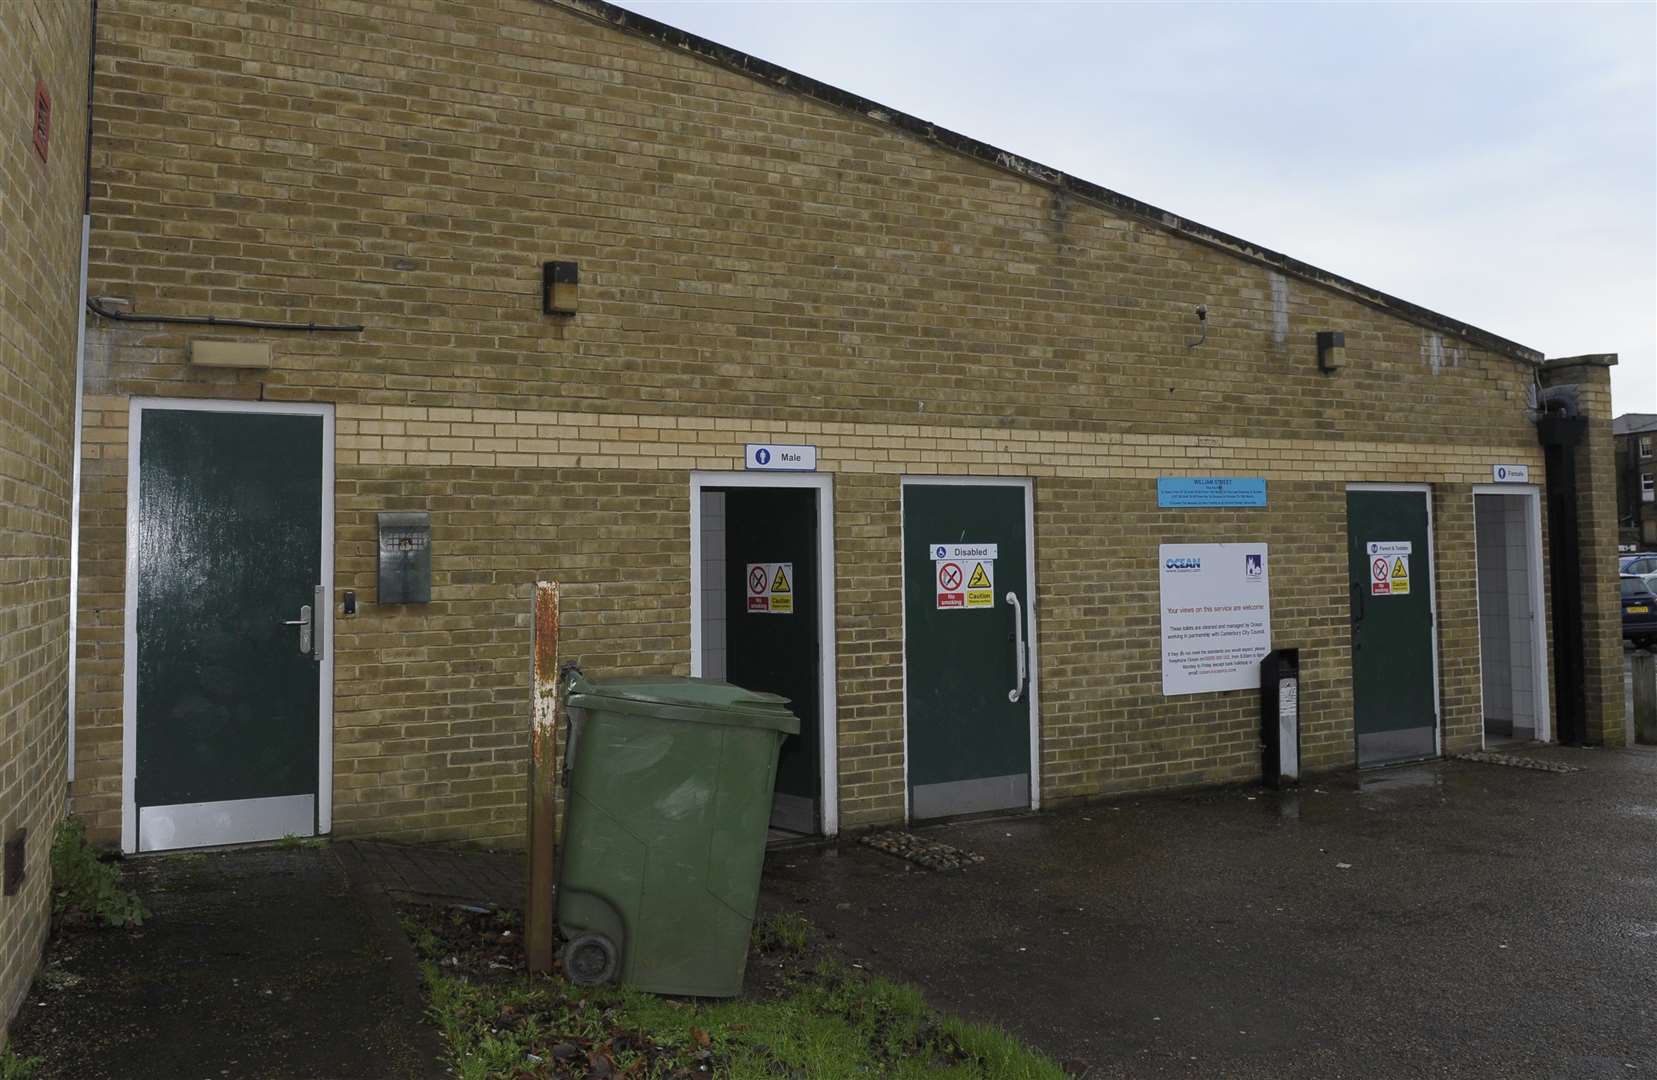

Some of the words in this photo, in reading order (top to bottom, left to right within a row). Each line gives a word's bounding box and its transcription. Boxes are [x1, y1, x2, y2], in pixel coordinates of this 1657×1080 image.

[781, 453, 801, 462] Male
[954, 548, 988, 556] Disabled
[1166, 558, 1201, 568] OCEAN
